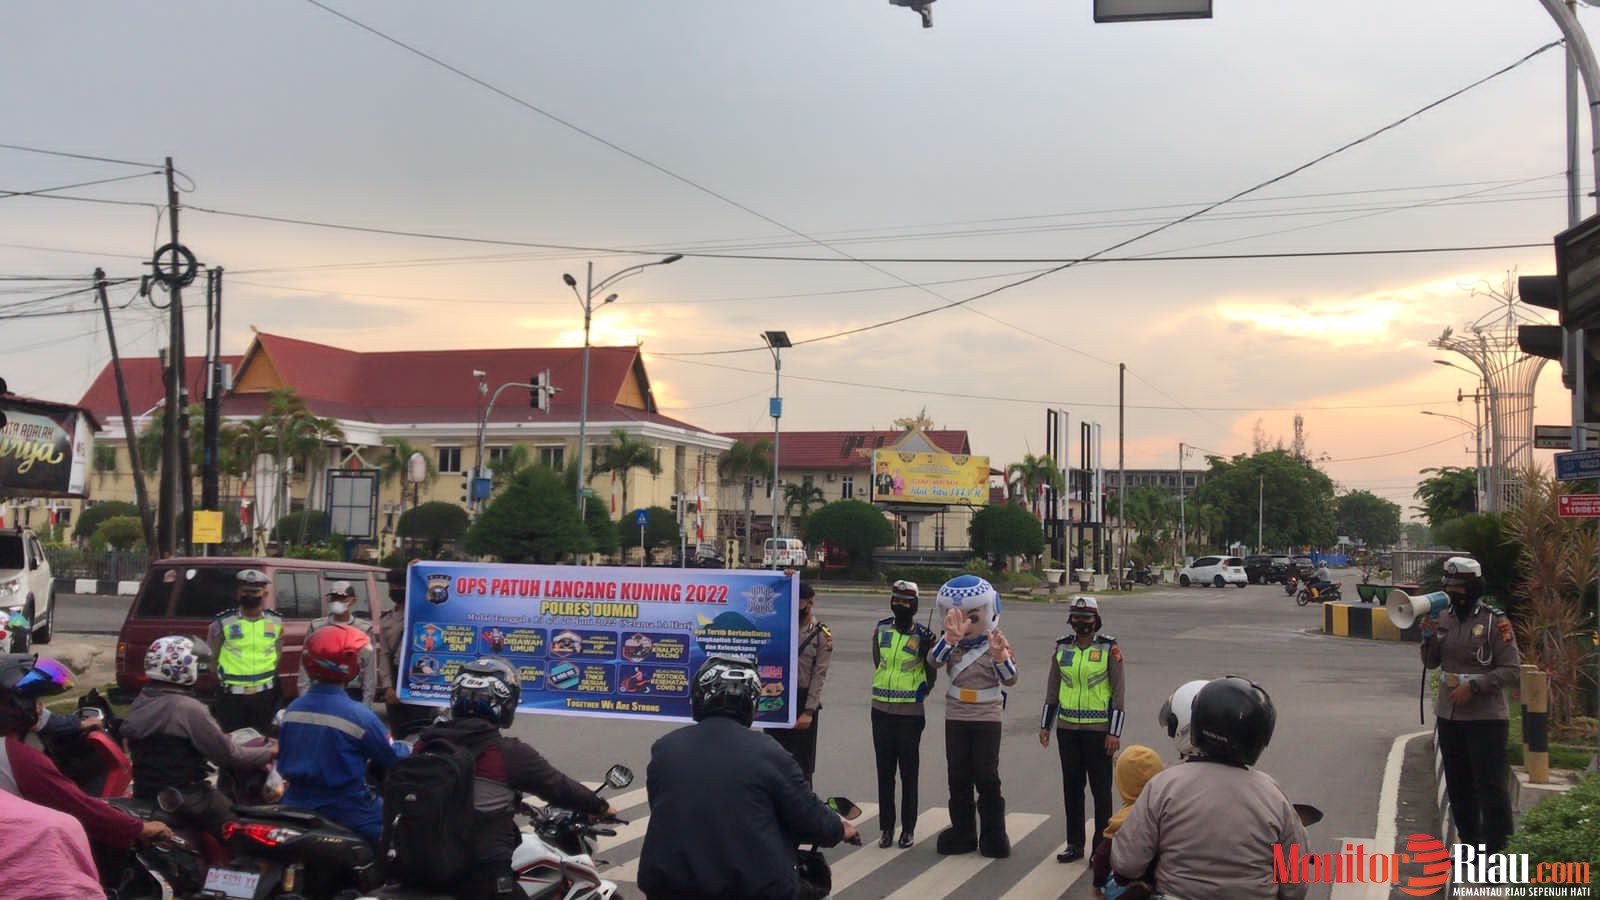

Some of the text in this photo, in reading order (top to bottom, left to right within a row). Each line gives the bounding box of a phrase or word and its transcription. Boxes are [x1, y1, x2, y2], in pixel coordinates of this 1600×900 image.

[21, 424, 53, 439] ADALAH
[456, 577, 487, 596] OPS
[491, 578, 540, 598] PATUH
[544, 580, 616, 601] LANCANG
[620, 583, 681, 603] KUNING
[685, 585, 728, 605] 2022
[540, 601, 638, 618] POLRES DUMAI
[443, 636, 472, 645] HELM
[504, 638, 543, 646] DIBAWAH
[449, 644, 466, 652] SNI
[510, 645, 535, 653] UMUR
[652, 646, 684, 654] KNALPOT
[585, 673, 604, 681] TNKB
[652, 673, 687, 681] PROTOKOL
